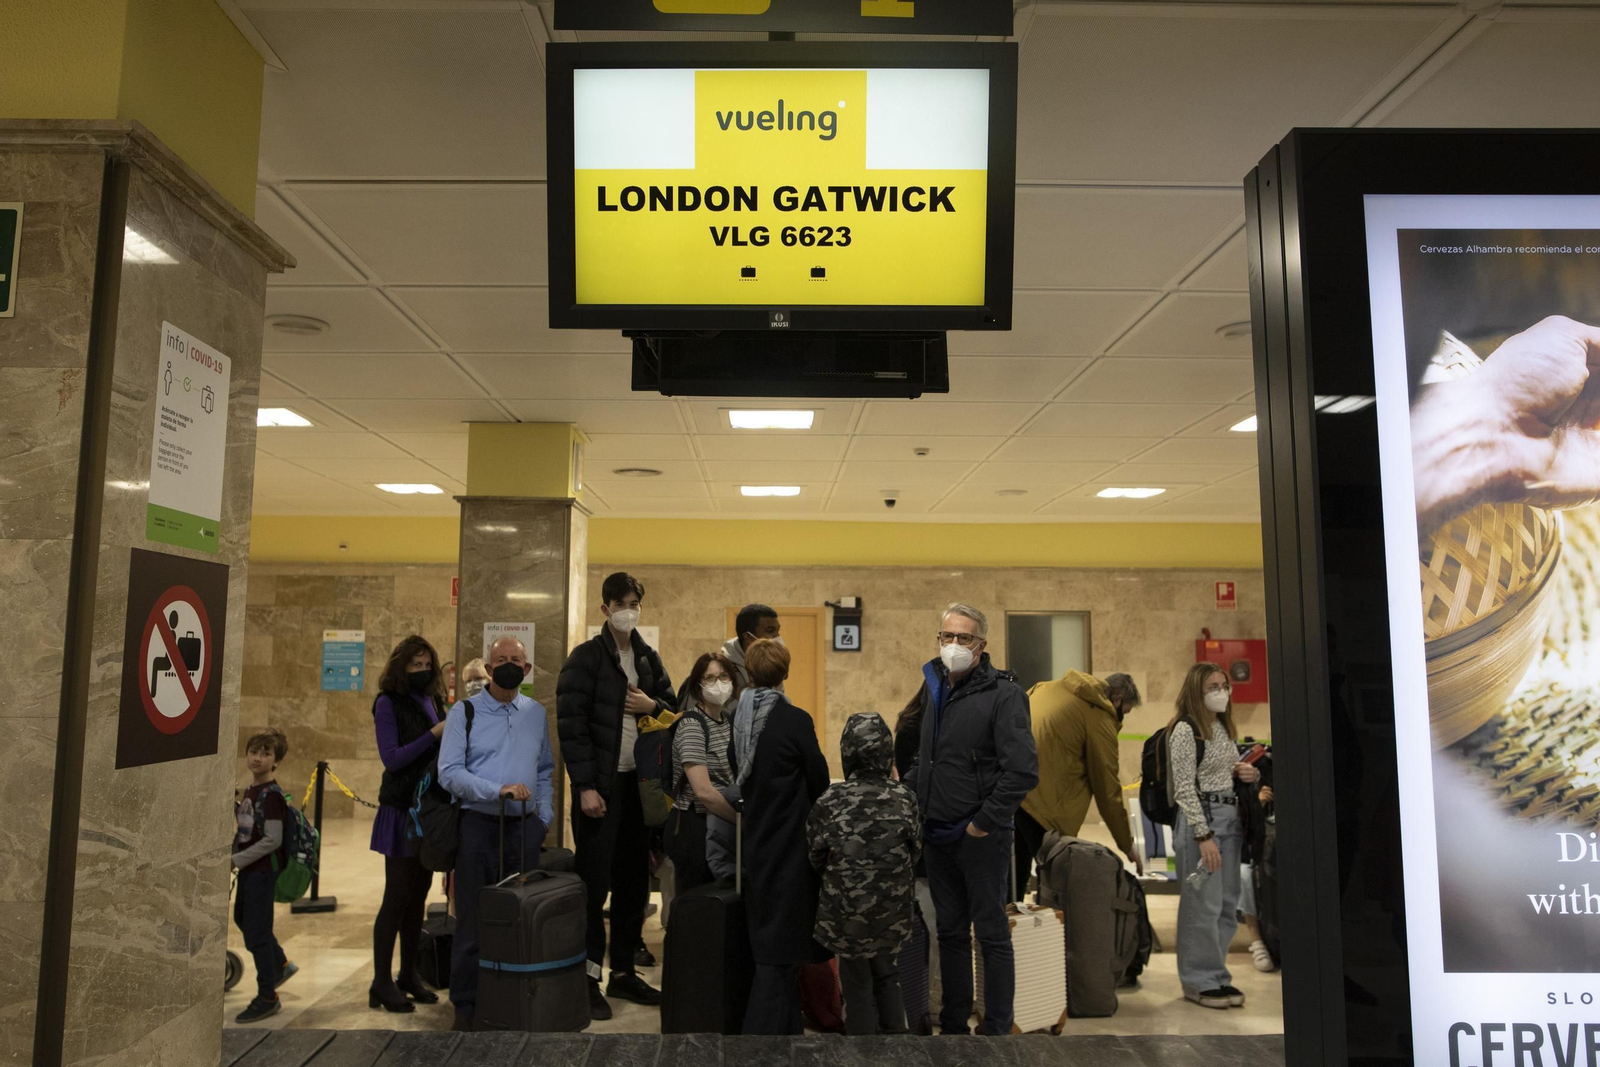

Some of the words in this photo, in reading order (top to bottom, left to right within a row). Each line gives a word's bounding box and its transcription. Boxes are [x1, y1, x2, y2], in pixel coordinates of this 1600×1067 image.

[715, 99, 839, 141] vueling
[597, 185, 759, 213] LONDON
[772, 185, 957, 213] GATWICK
[709, 226, 771, 247] VLG
[780, 226, 852, 247] 6623
[1419, 244, 1464, 254] Cervezas
[1465, 244, 1513, 254] Alhambra
[1515, 244, 1572, 254] recomienda
[1574, 245, 1583, 254] el
[166, 330, 185, 354] info
[190, 347, 223, 374] COVID-19
[1555, 831, 1600, 863] Di
[1526, 882, 1600, 915] with
[1547, 991, 1594, 1005] SLO
